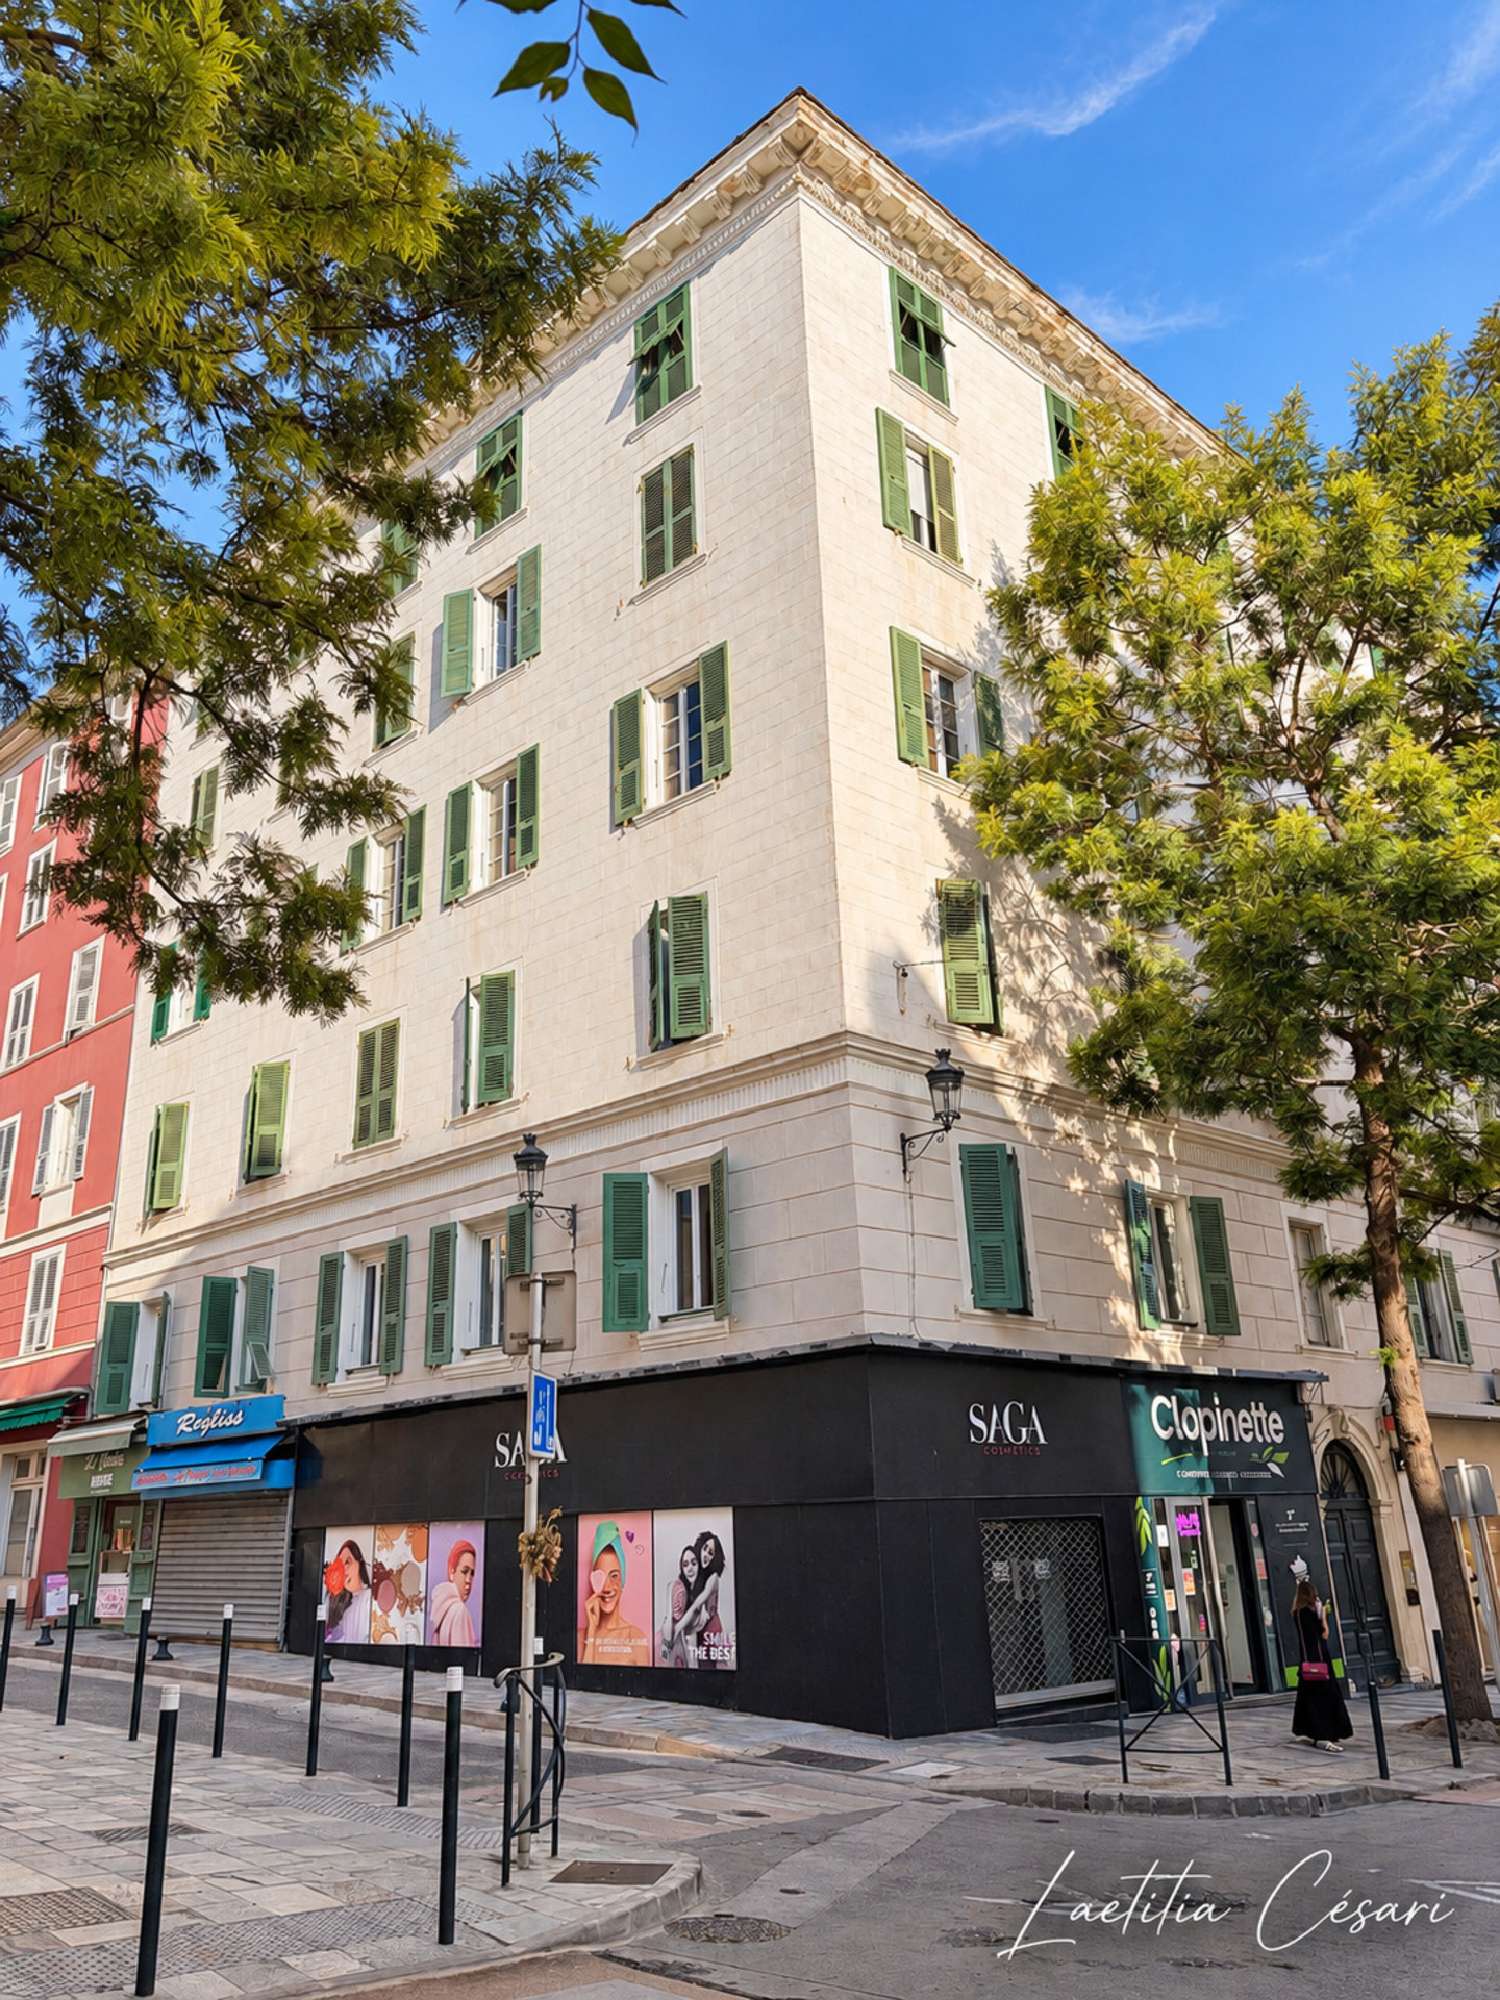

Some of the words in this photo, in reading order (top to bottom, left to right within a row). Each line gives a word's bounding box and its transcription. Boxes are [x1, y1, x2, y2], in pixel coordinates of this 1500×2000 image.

[969, 1400, 1048, 1445] SAGA
[1151, 1393, 1285, 1456] Clopinette
[495, 1430, 568, 1468] SAA
